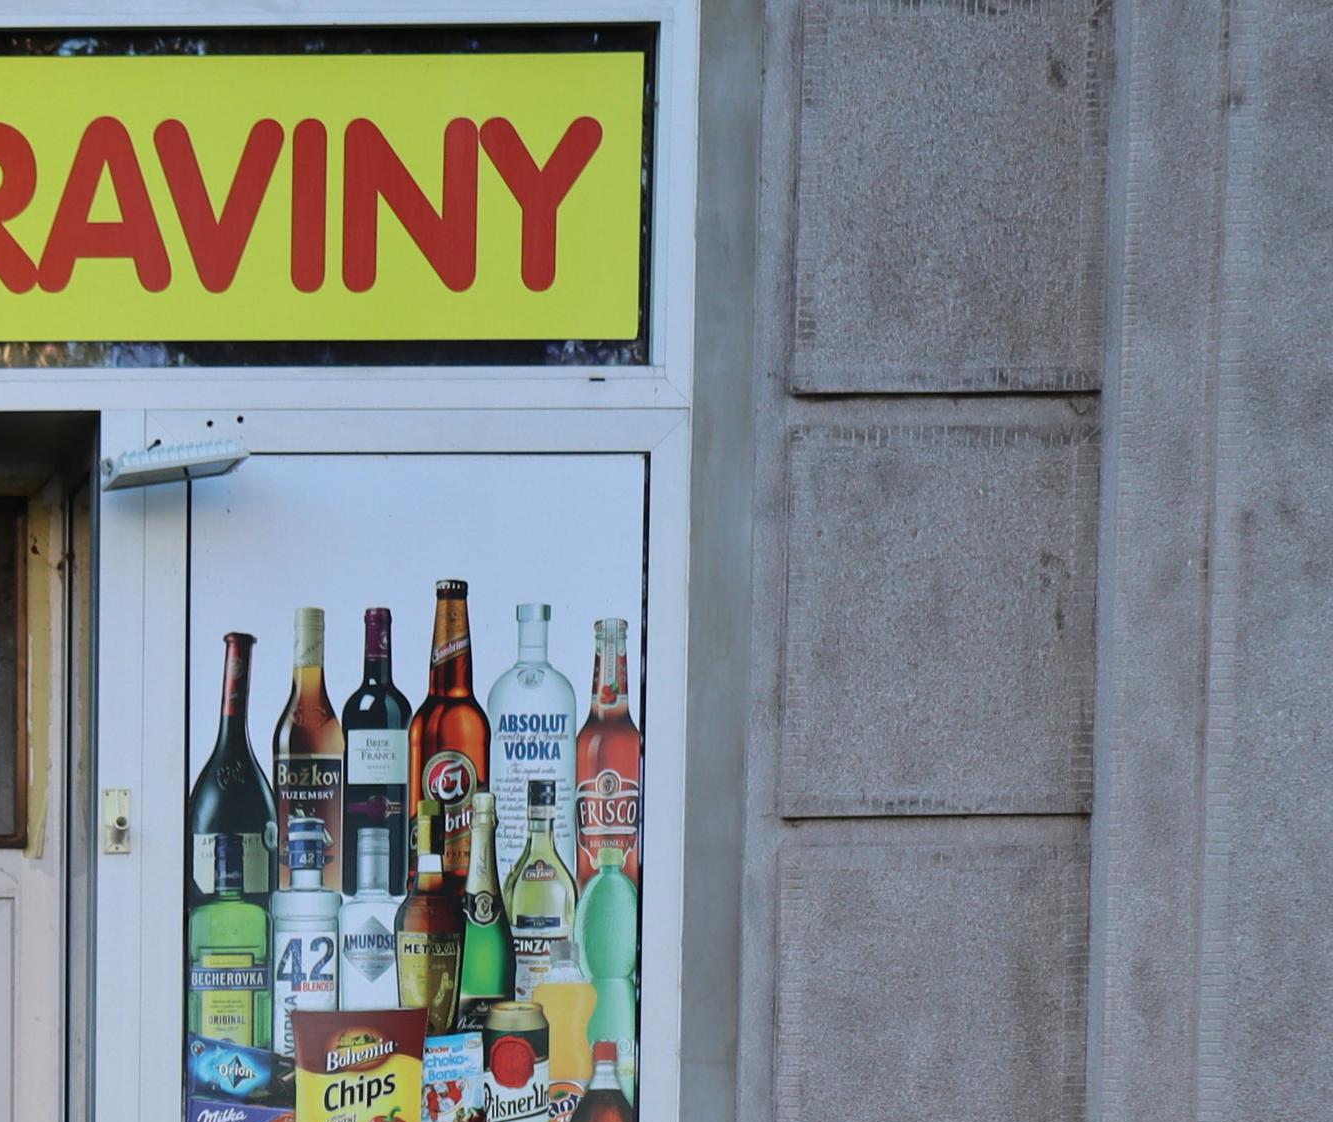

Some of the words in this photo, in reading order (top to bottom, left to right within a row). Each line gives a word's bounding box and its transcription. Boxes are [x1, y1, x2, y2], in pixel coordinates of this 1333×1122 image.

[499, 714, 568, 733] ABSOLUT
[361, 751, 396, 761] FRANCE
[504, 742, 561, 760] VODKA
[276, 763, 340, 786] Božkov
[580, 799, 637, 826] FRISCO
[299, 853, 315, 863] 42
[343, 934, 396, 951] AMUNDSE
[404, 943, 457, 956] METAXA
[513, 939, 552, 955] CINZA
[276, 937, 334, 992] 42
[191, 971, 265, 987] BECHEROVKA
[208, 1015, 246, 1026] ORIGINAL
[326, 1038, 395, 1073] Bohemia
[218, 1062, 254, 1079] Orion
[324, 1073, 396, 1112] Chips
